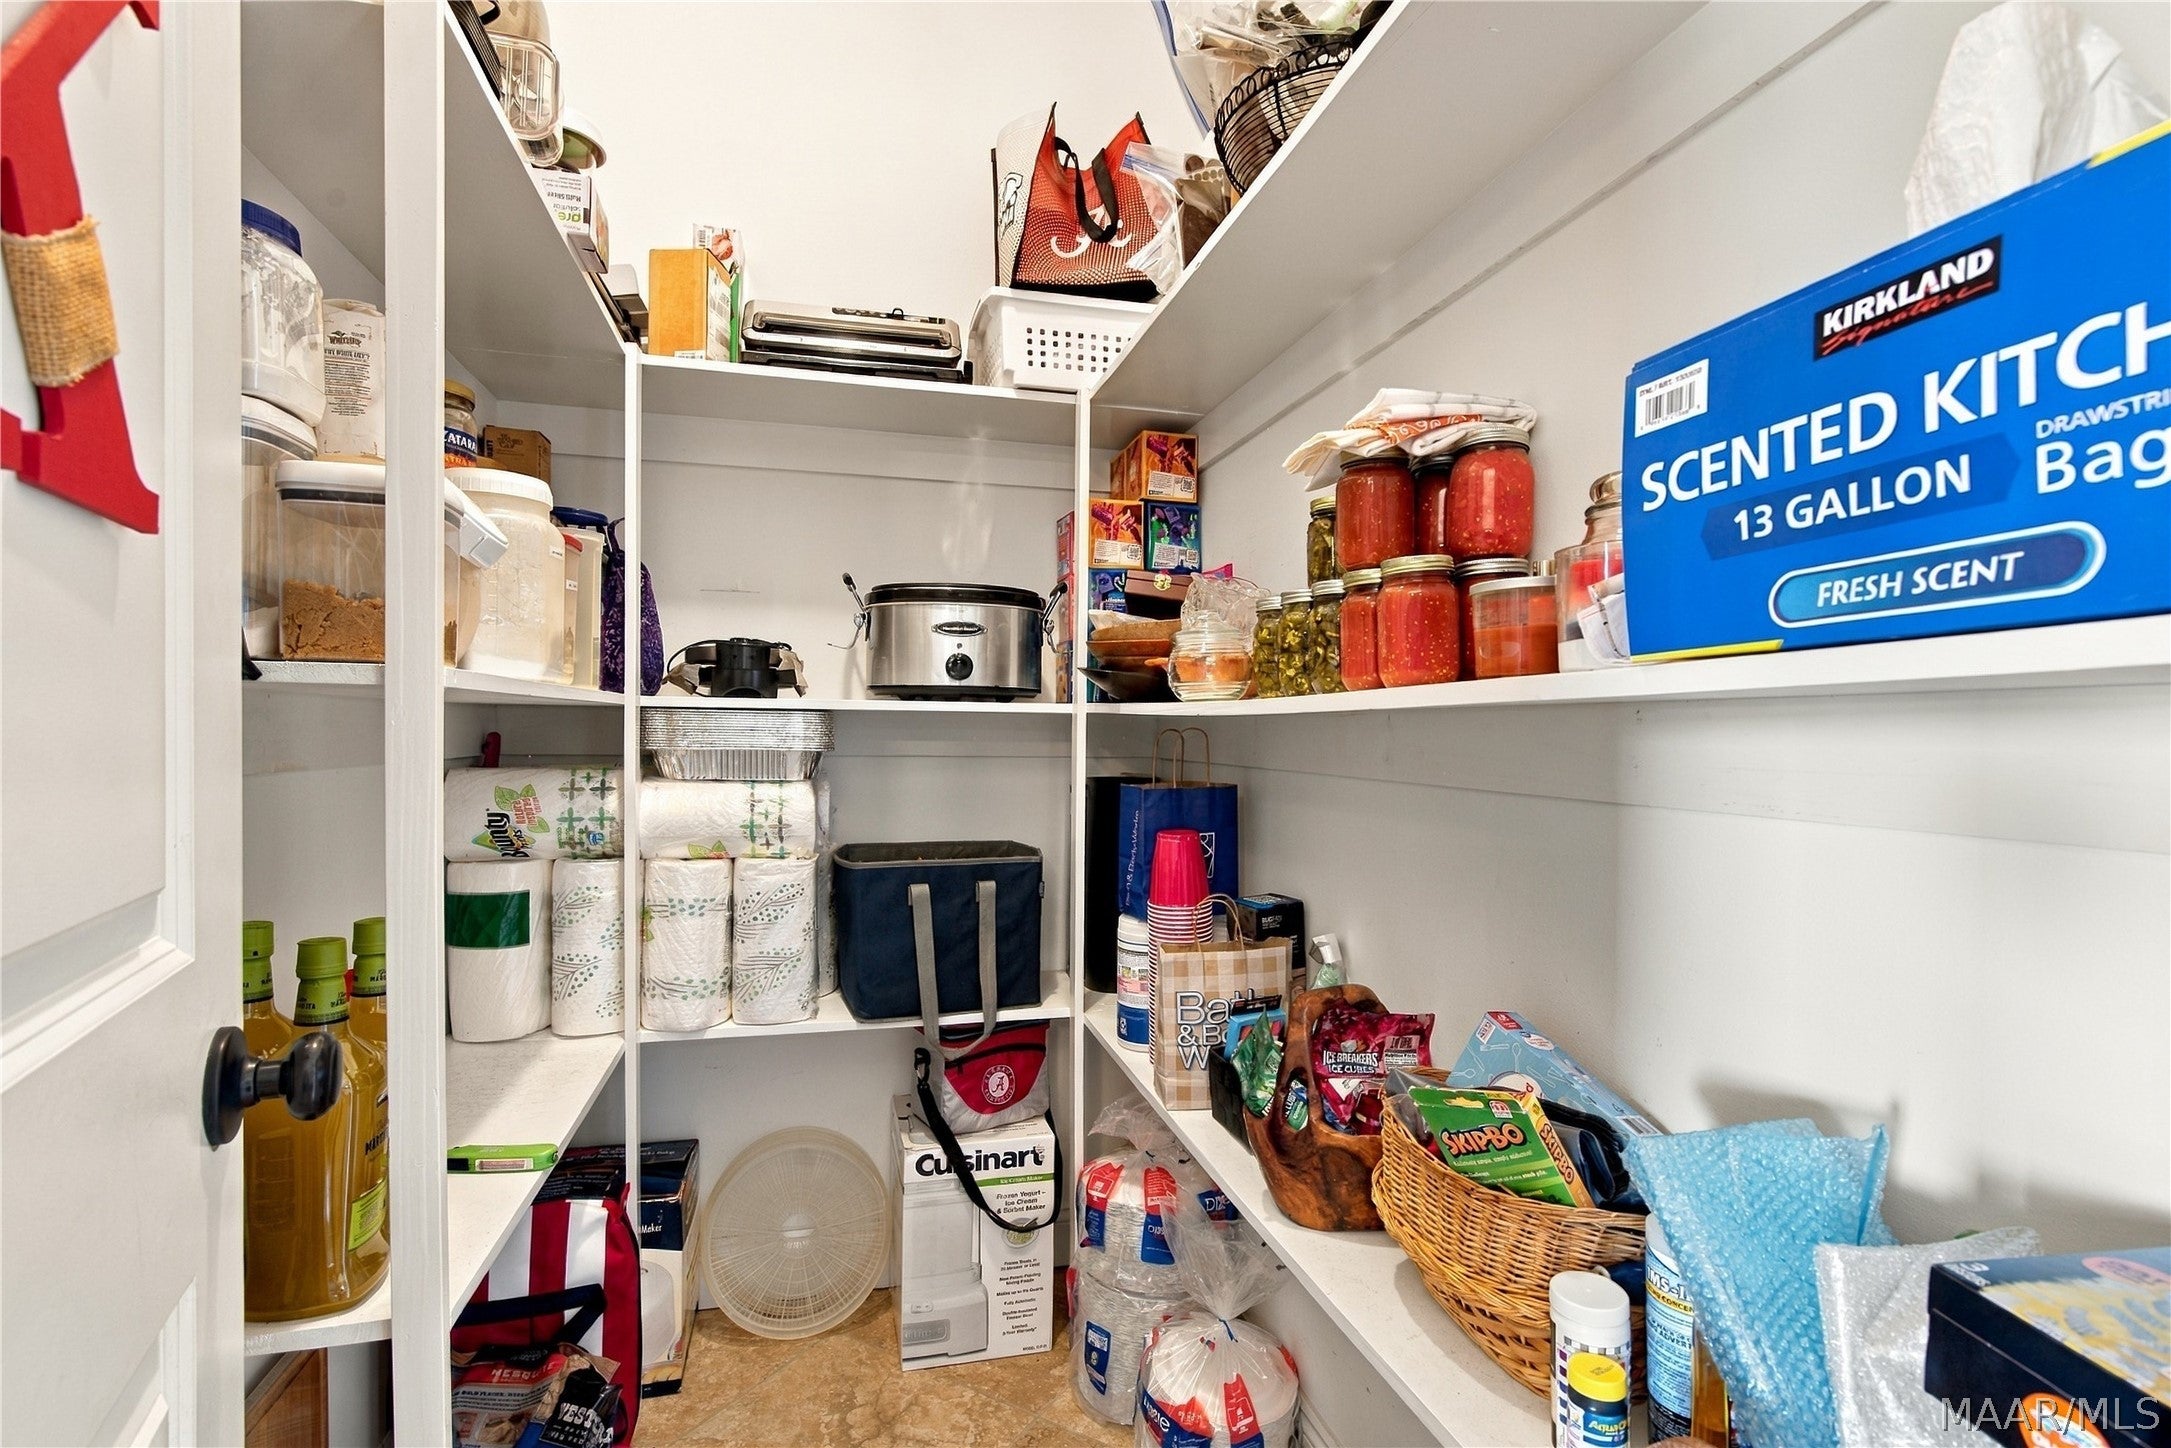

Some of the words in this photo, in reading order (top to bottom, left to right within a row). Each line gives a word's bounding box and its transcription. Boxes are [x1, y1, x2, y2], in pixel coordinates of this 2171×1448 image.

[1821, 281, 1994, 356] Signature
[1822, 247, 1995, 338] KIRKLAND
[1641, 391, 1898, 513] SCENTED
[1733, 503, 1775, 543] 13
[1785, 454, 1972, 531] GALLON
[1816, 569, 1902, 609] FRESH
[1911, 551, 2025, 598] SCENT
[1177, 1024, 1199, 1046] &
[1323, 1050, 1337, 1066] ICE
[1337, 1051, 1379, 1067] BREAKERS
[1327, 1064, 1344, 1074] ICE
[1344, 1065, 1376, 1074] CUBES
